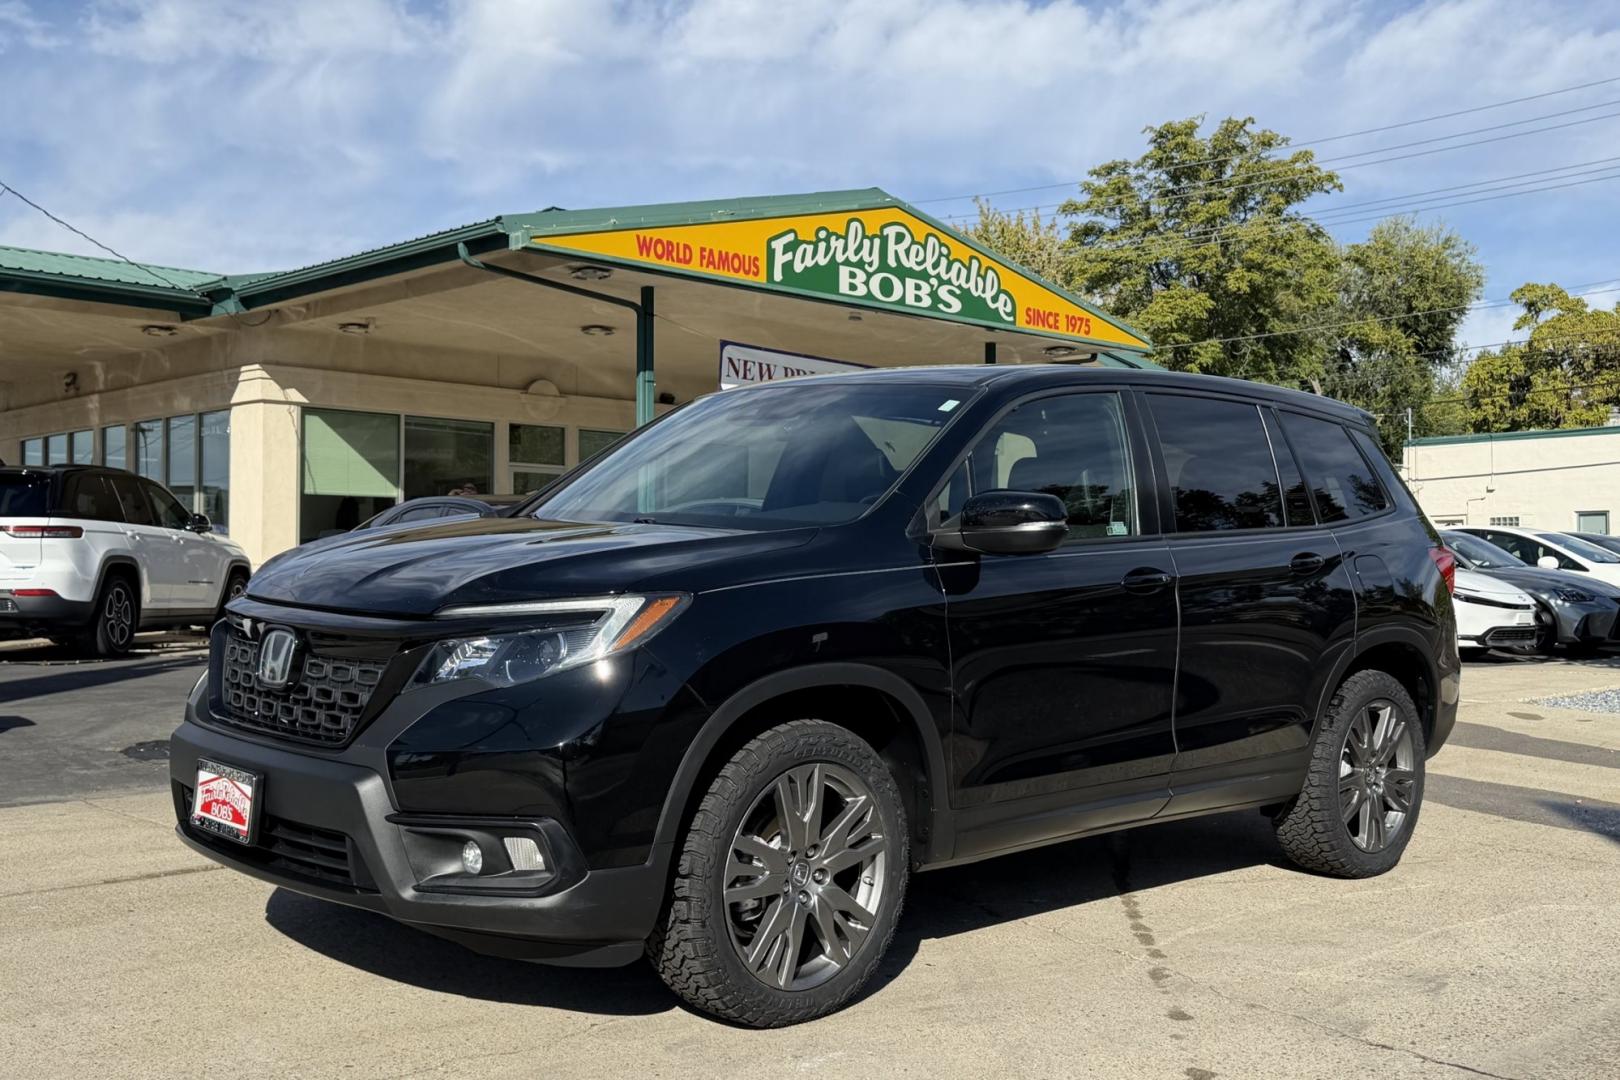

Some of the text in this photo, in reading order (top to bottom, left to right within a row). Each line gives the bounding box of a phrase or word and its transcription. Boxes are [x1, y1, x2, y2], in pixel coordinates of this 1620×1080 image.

[636, 234, 760, 277] WORLD FAMOUS
[771, 221, 1014, 321] Fairly Reliable
[839, 265, 962, 313] BOB'S
[1025, 306, 1091, 336] SINCE 1975
[726, 356, 778, 382] NEW
